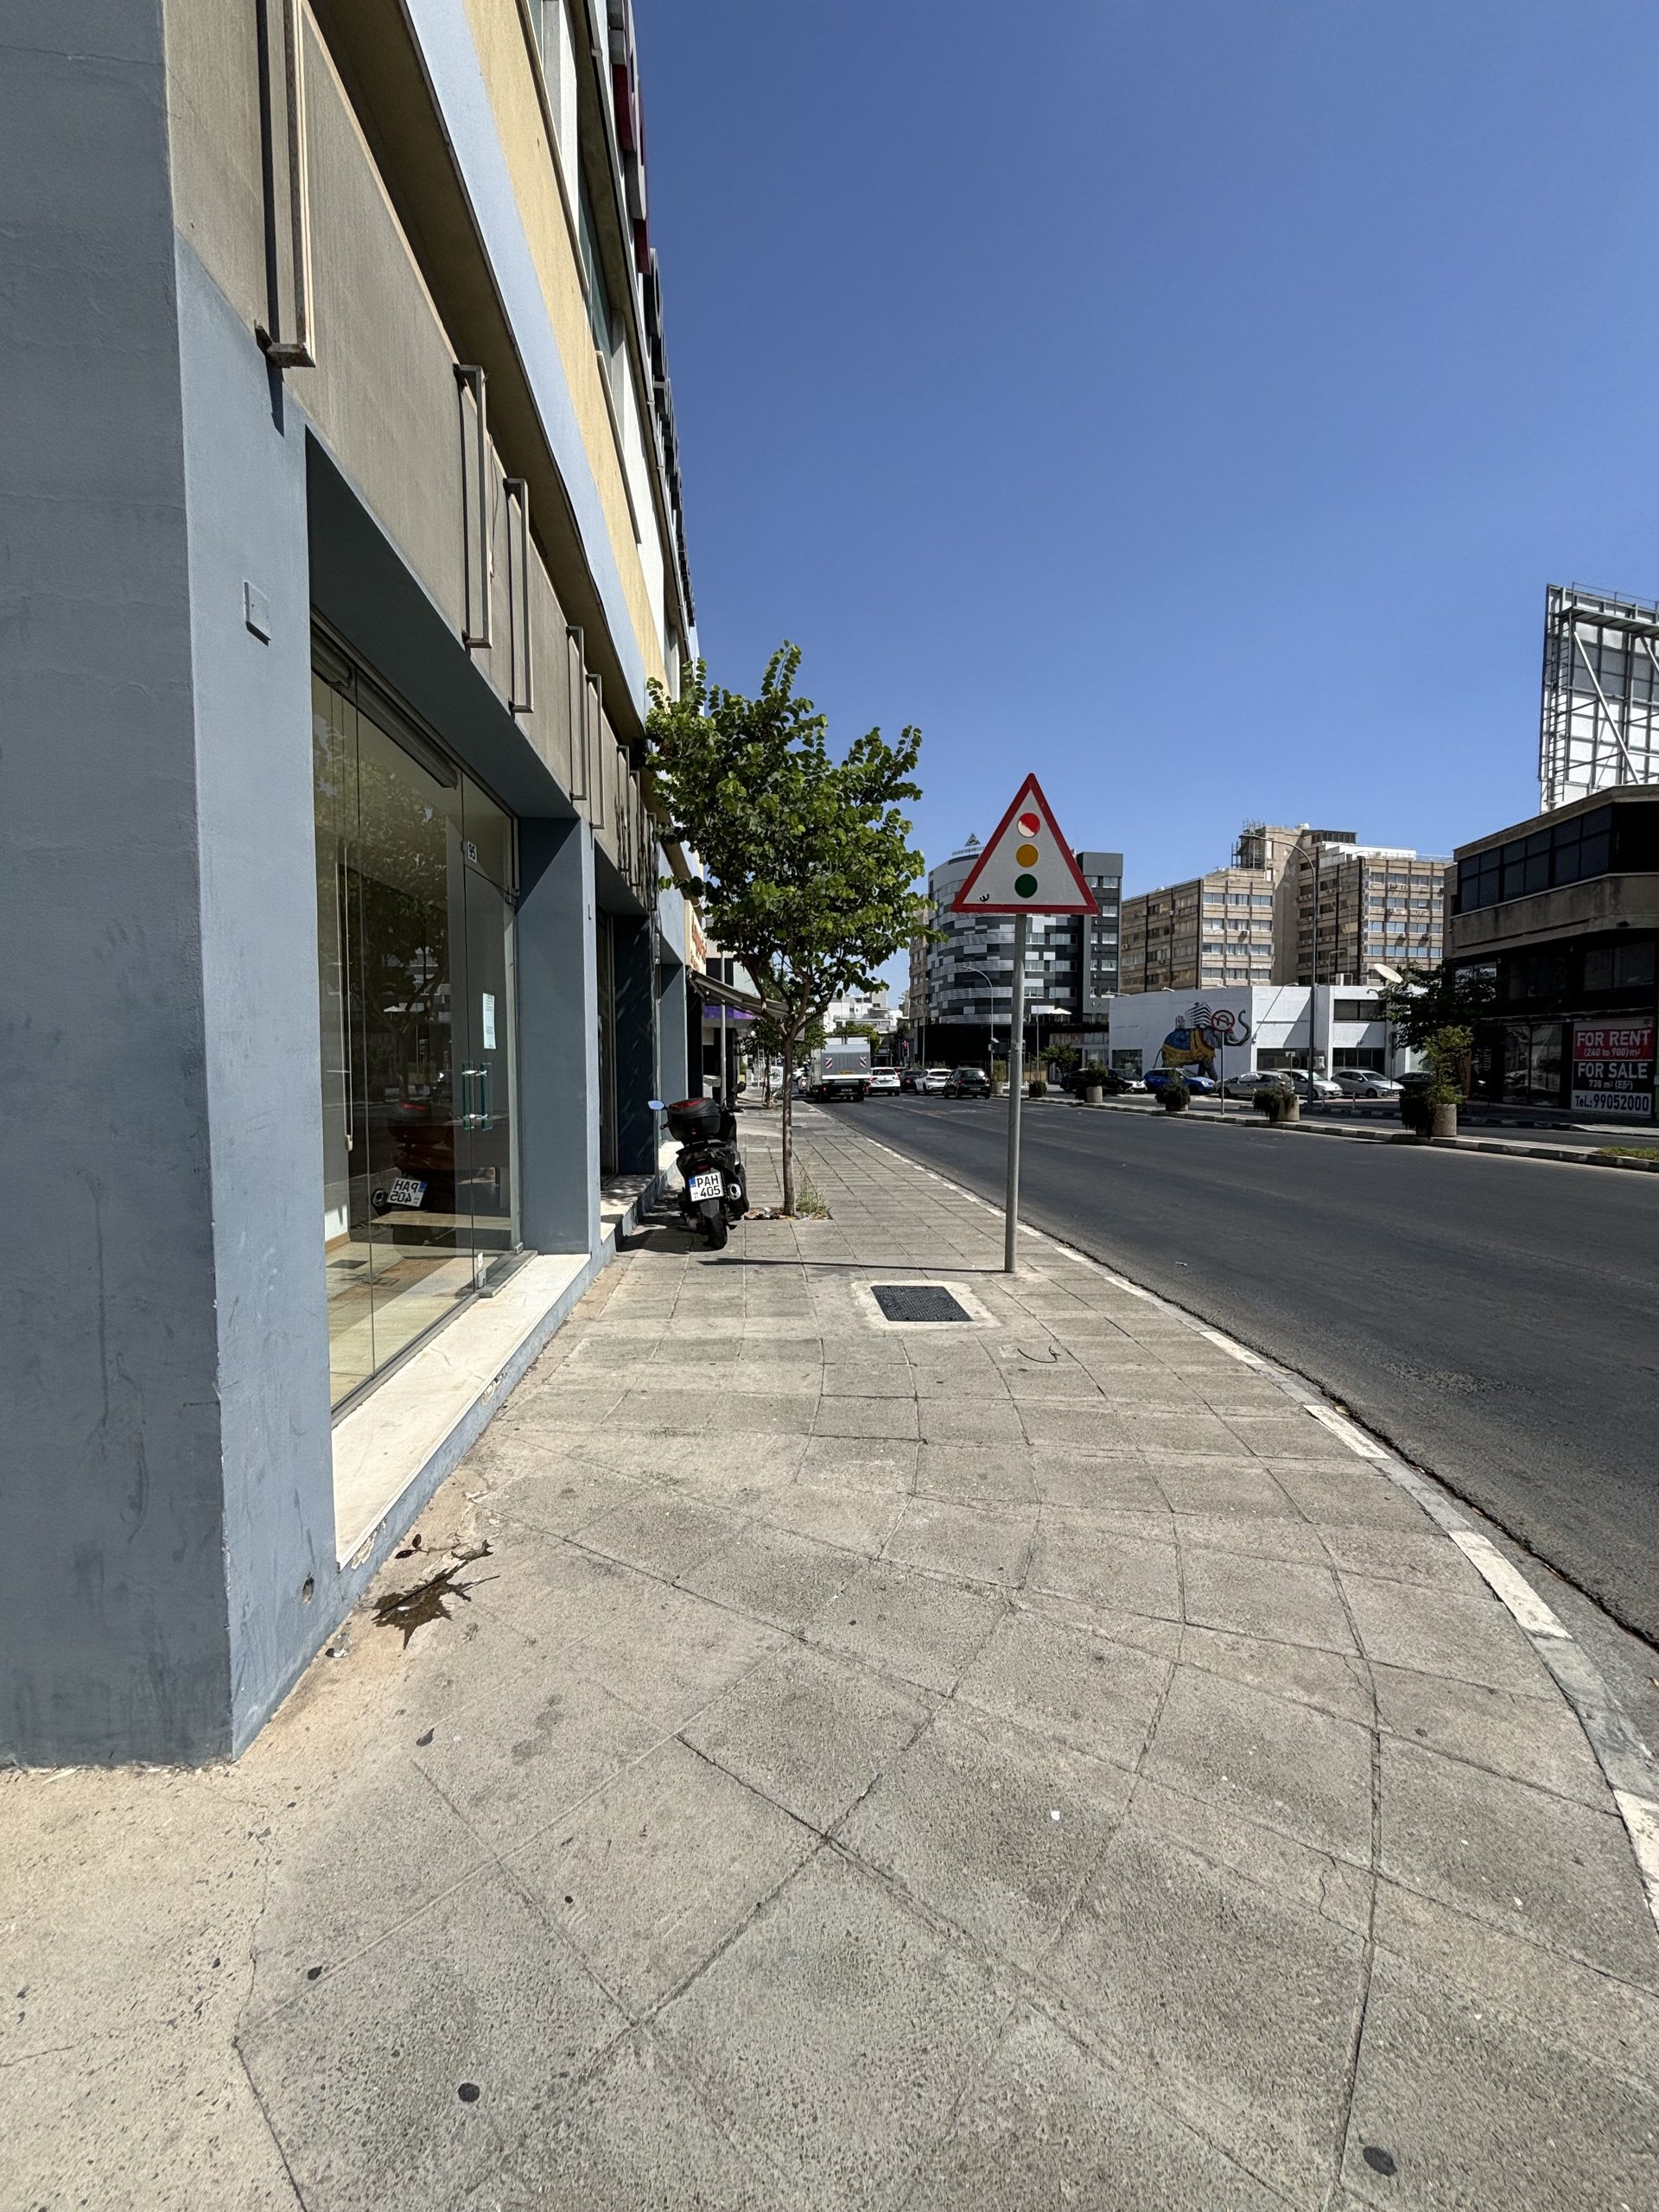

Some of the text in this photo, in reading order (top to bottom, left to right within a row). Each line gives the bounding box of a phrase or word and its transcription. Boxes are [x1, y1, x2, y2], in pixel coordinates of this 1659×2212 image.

[468, 842, 475, 861] 95
[1577, 1029, 1651, 1046] FOR RENT
[1578, 1062, 1648, 1079] FOR SALE
[1593, 1094, 1649, 1112] 99052000
[696, 1174, 719, 1188] PAH
[700, 1185, 721, 1198] 405
